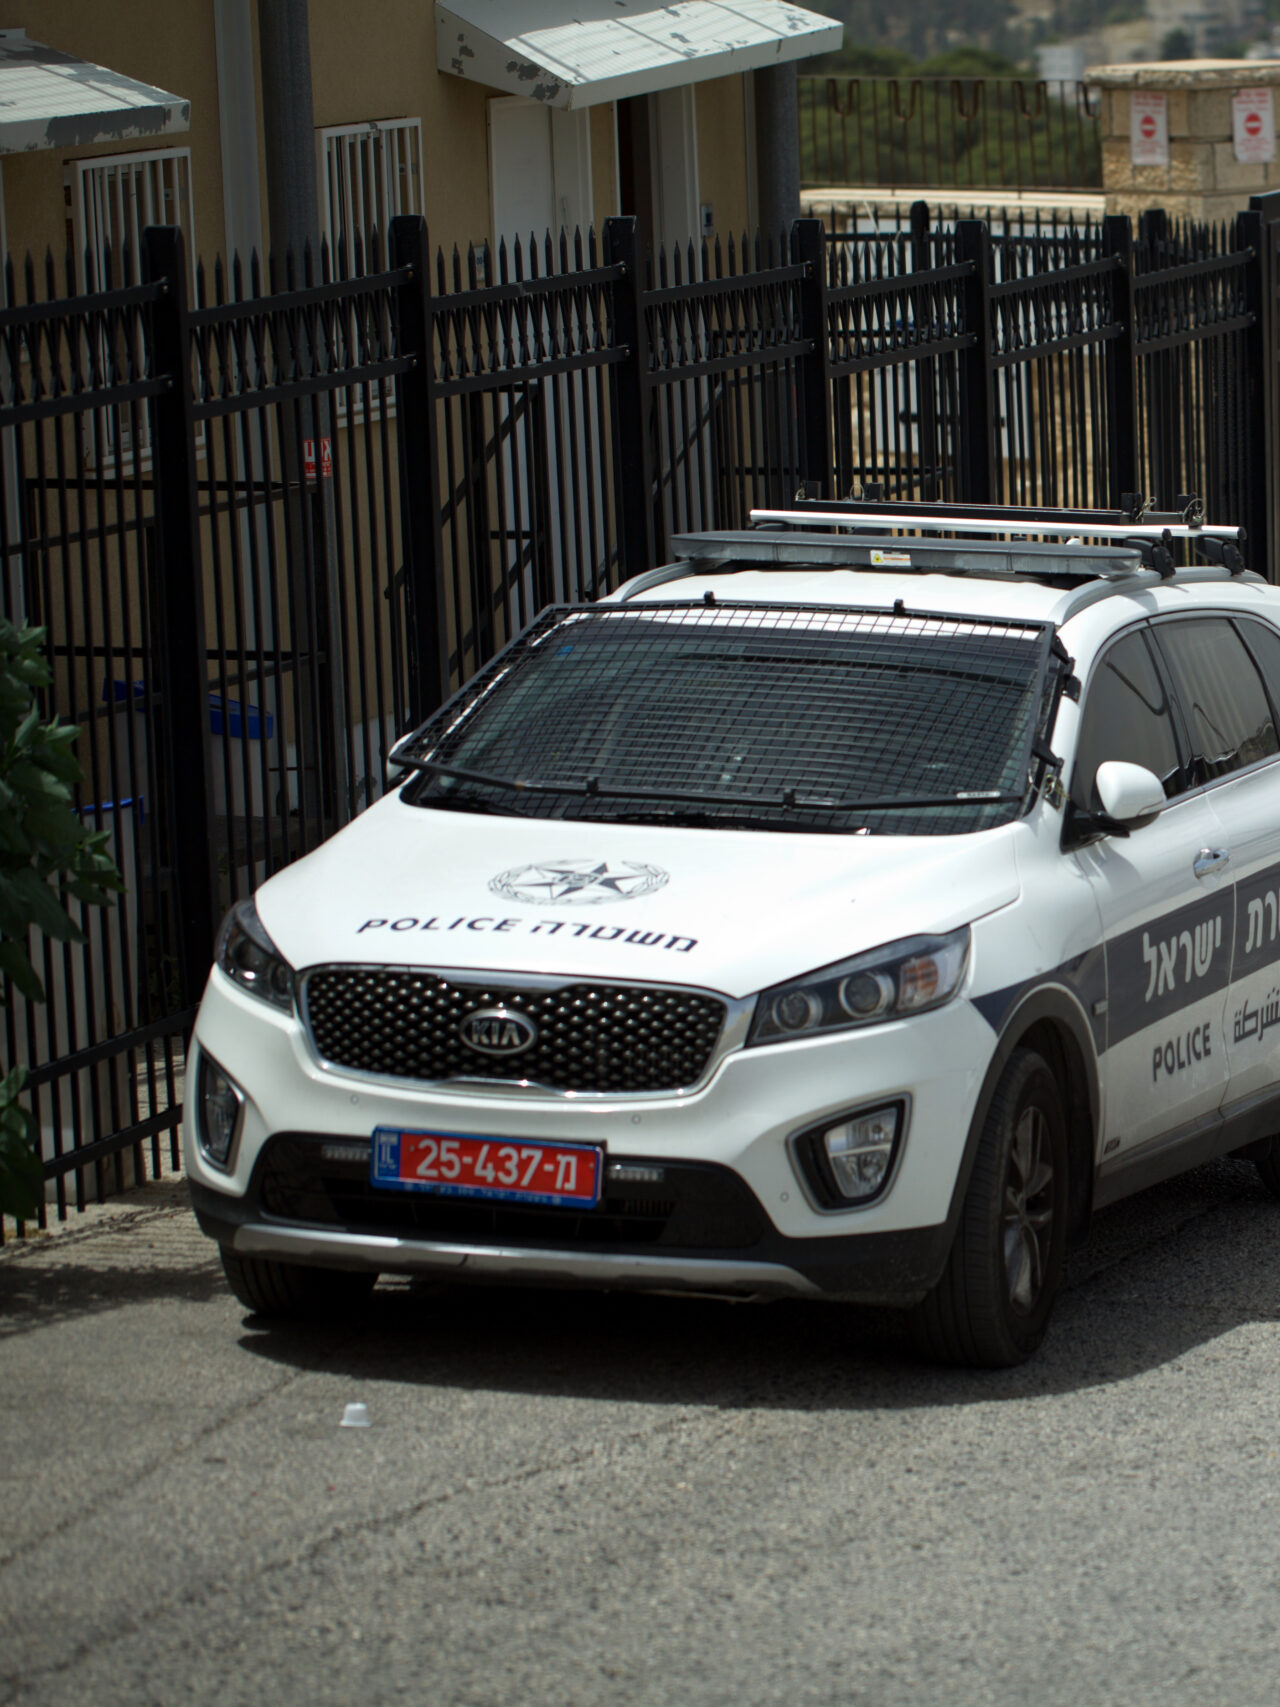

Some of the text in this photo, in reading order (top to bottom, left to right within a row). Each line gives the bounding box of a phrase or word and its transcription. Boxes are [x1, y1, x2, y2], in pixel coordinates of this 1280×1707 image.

[356, 917, 522, 934] POLICE
[530, 919, 700, 953] משטרה
[1143, 916, 1222, 1003] ישראל
[470, 1019, 521, 1046] KIA
[1152, 1021, 1212, 1083] POLICE
